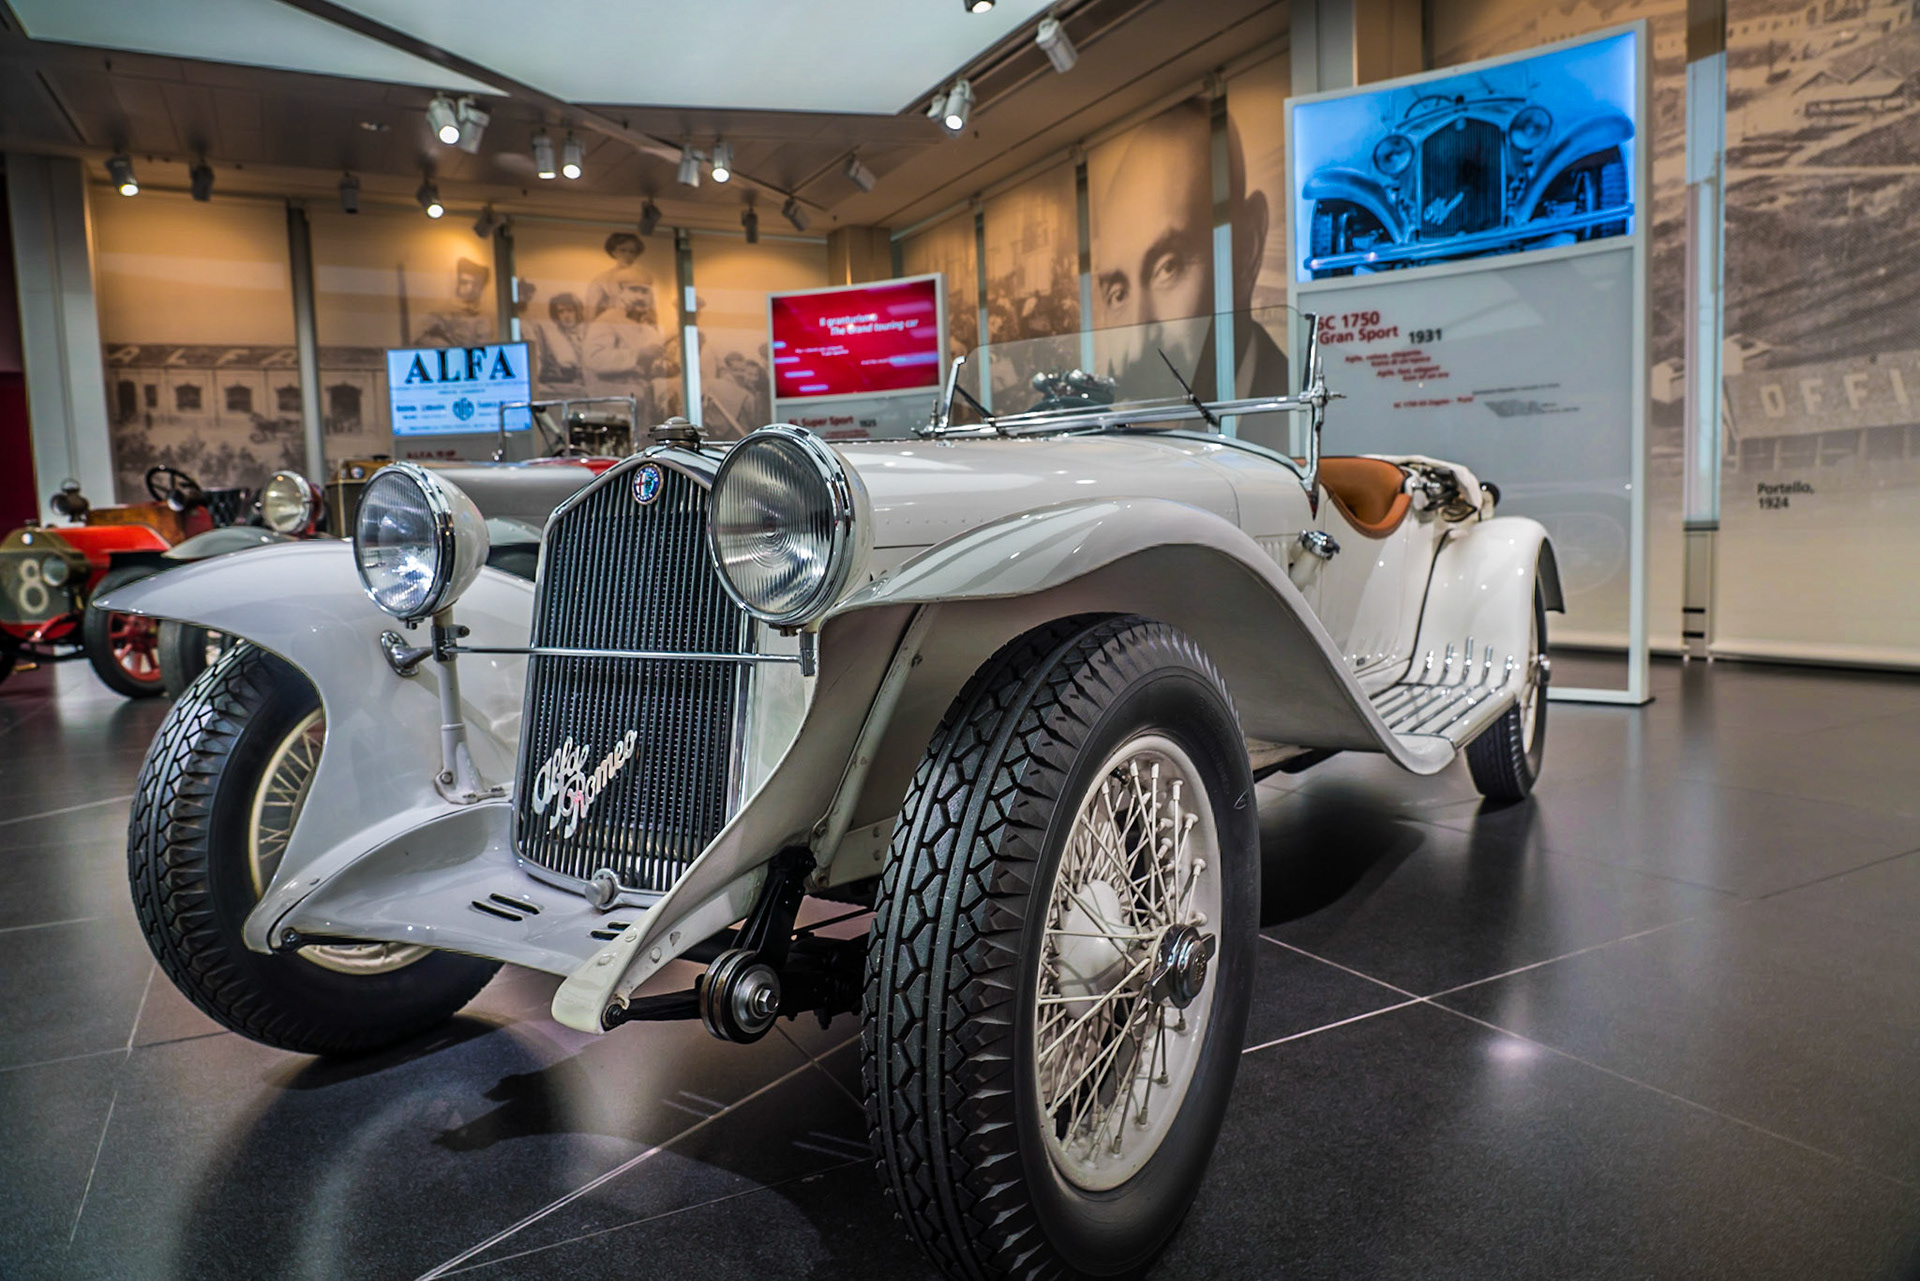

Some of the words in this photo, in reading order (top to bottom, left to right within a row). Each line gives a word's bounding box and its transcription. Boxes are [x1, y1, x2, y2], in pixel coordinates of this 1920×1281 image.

[830, 324, 845, 336] The
[874, 320, 904, 332] touring
[905, 319, 919, 328] car
[1342, 311, 1380, 328] 1750
[1319, 331, 1354, 345] Gran
[1358, 326, 1399, 343] Sport
[1408, 328, 1442, 344] 1931
[405, 346, 516, 384] ALFA
[1757, 480, 1815, 495] Portello,
[1759, 496, 1789, 509] 1924
[19, 558, 49, 615] 8
[533, 736, 588, 830] Alfa
[562, 730, 637, 838] Romeo
